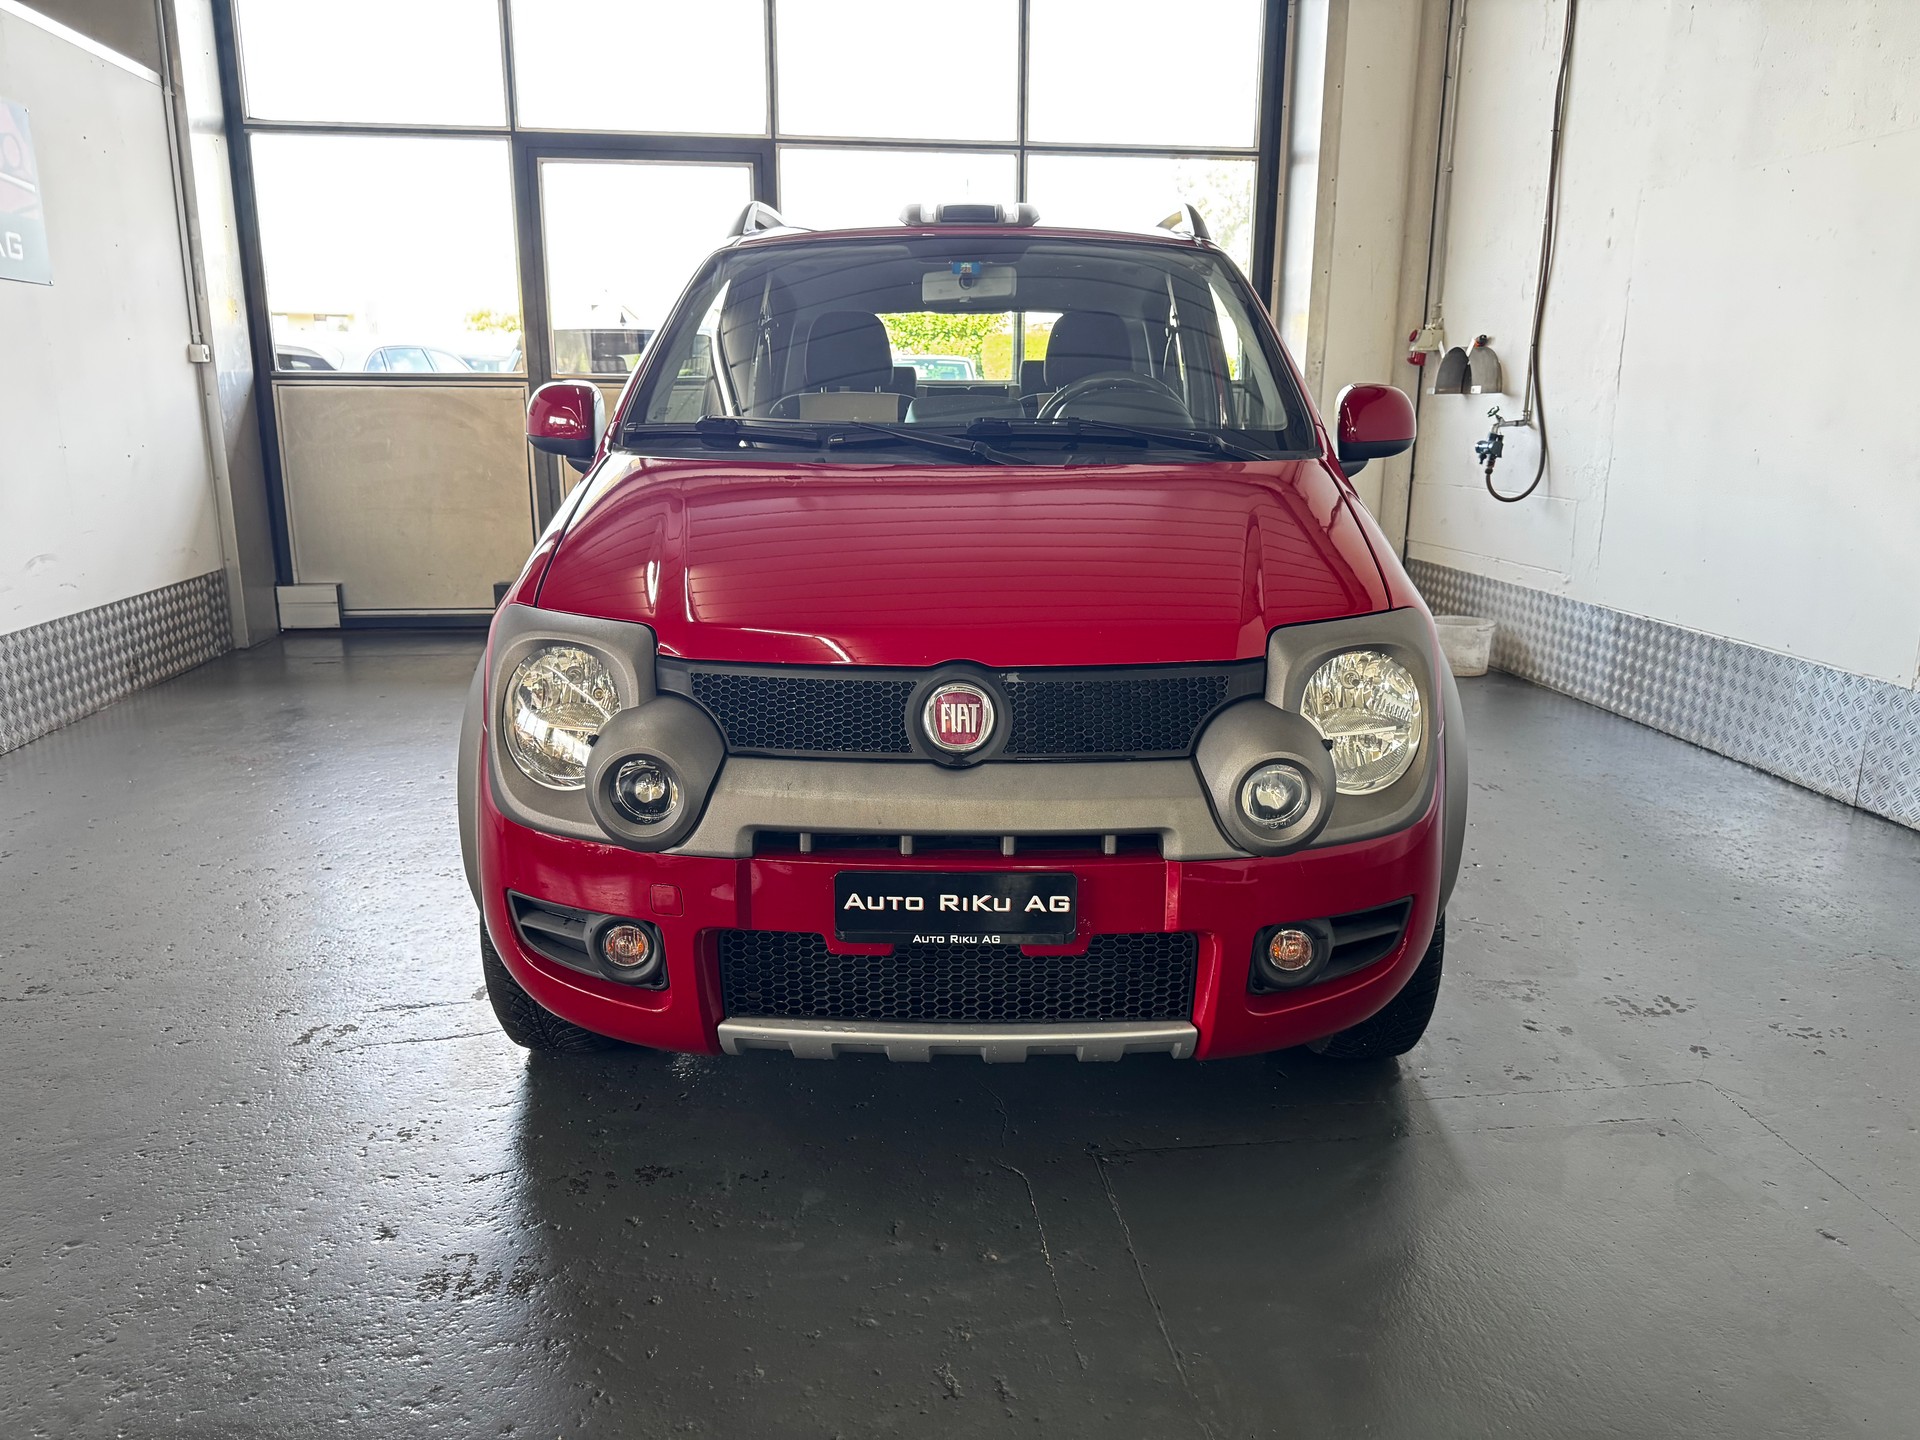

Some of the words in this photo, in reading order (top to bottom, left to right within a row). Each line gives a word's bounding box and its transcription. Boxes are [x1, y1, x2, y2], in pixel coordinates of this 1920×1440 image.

[940, 703, 980, 733] FIAT
[1023, 895, 1071, 913] AG
[981, 934, 1001, 944] AG
